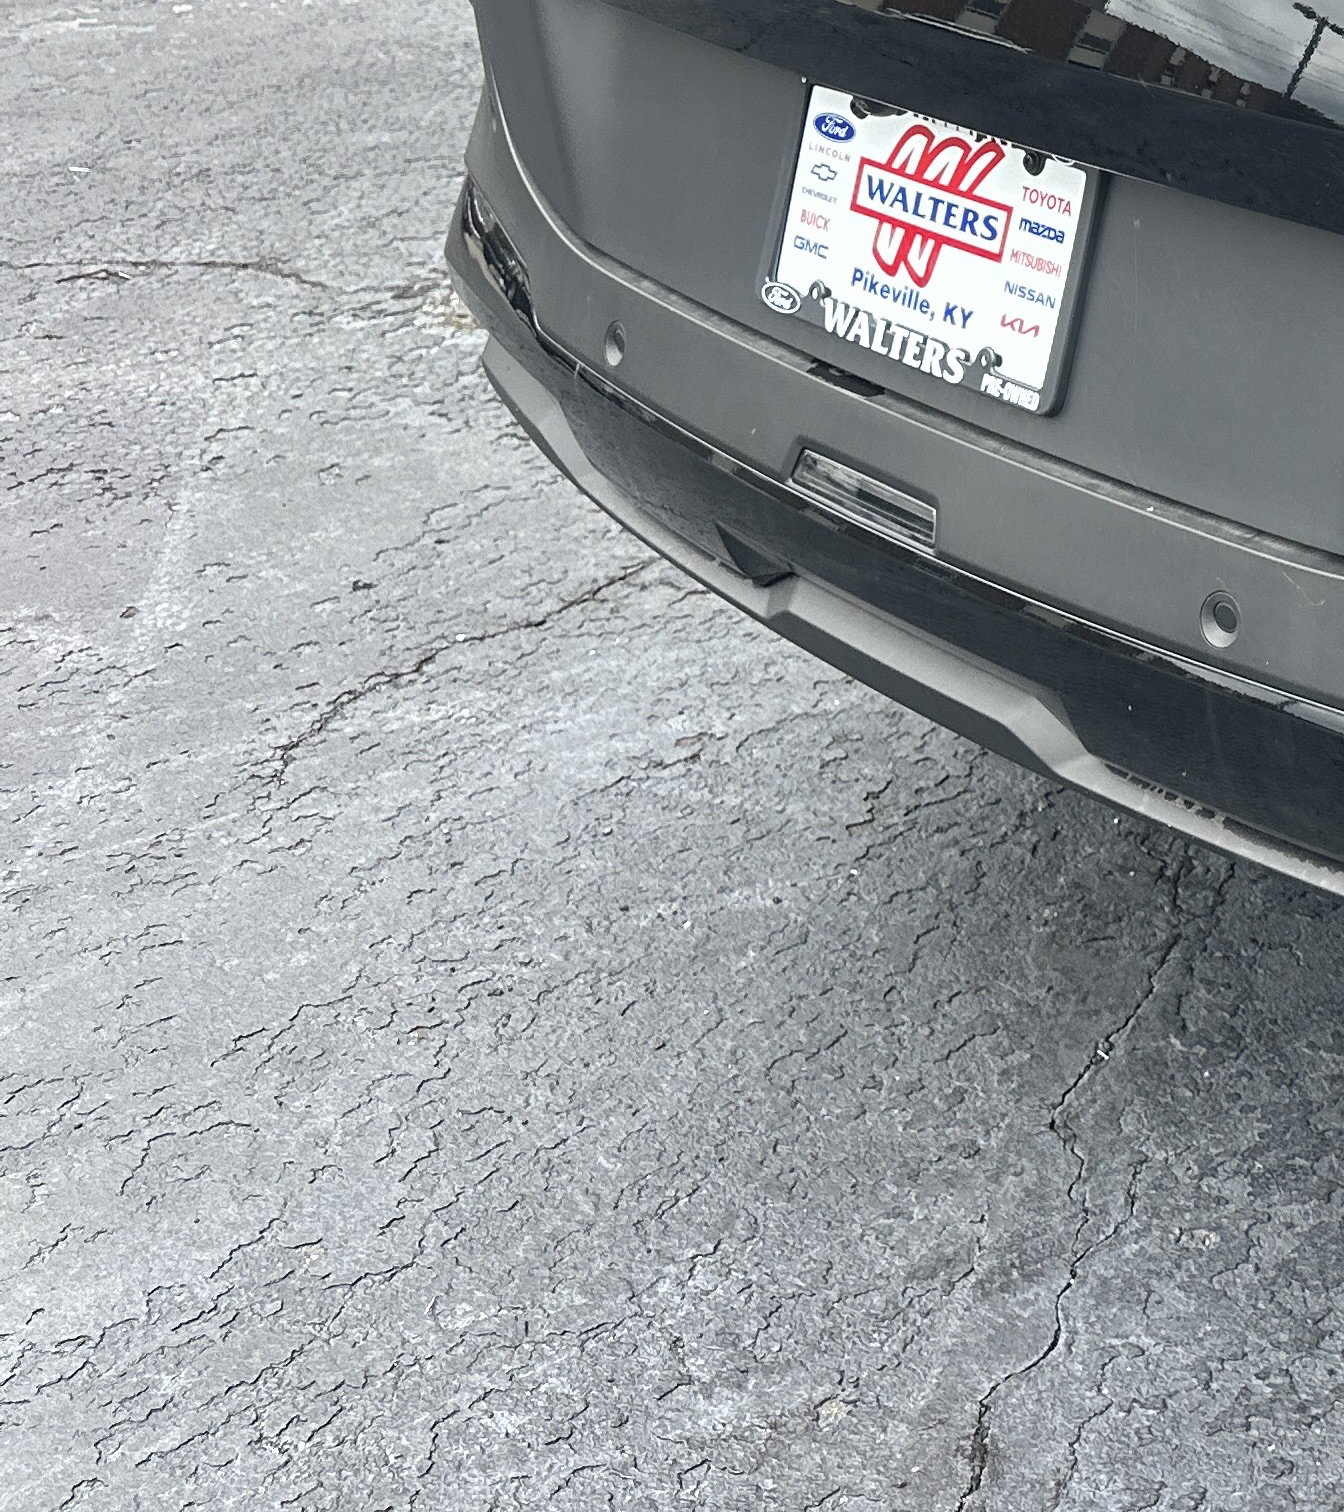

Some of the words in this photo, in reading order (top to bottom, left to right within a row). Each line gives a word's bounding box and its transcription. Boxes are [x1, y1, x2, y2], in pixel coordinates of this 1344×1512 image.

[808, 142, 851, 163] LINCOLN
[866, 174, 998, 242] WALTERS
[1022, 186, 1072, 216] TOYOTA
[800, 208, 831, 232] BUICK
[793, 234, 829, 260] GMC
[1010, 248, 1062, 278] MITSUBISHI
[850, 267, 936, 322] Pikeville,
[943, 302, 975, 330] KY
[1004, 280, 1056, 309] NISSAN
[1000, 313, 1040, 338] KIA
[823, 296, 965, 385] WALTERS
